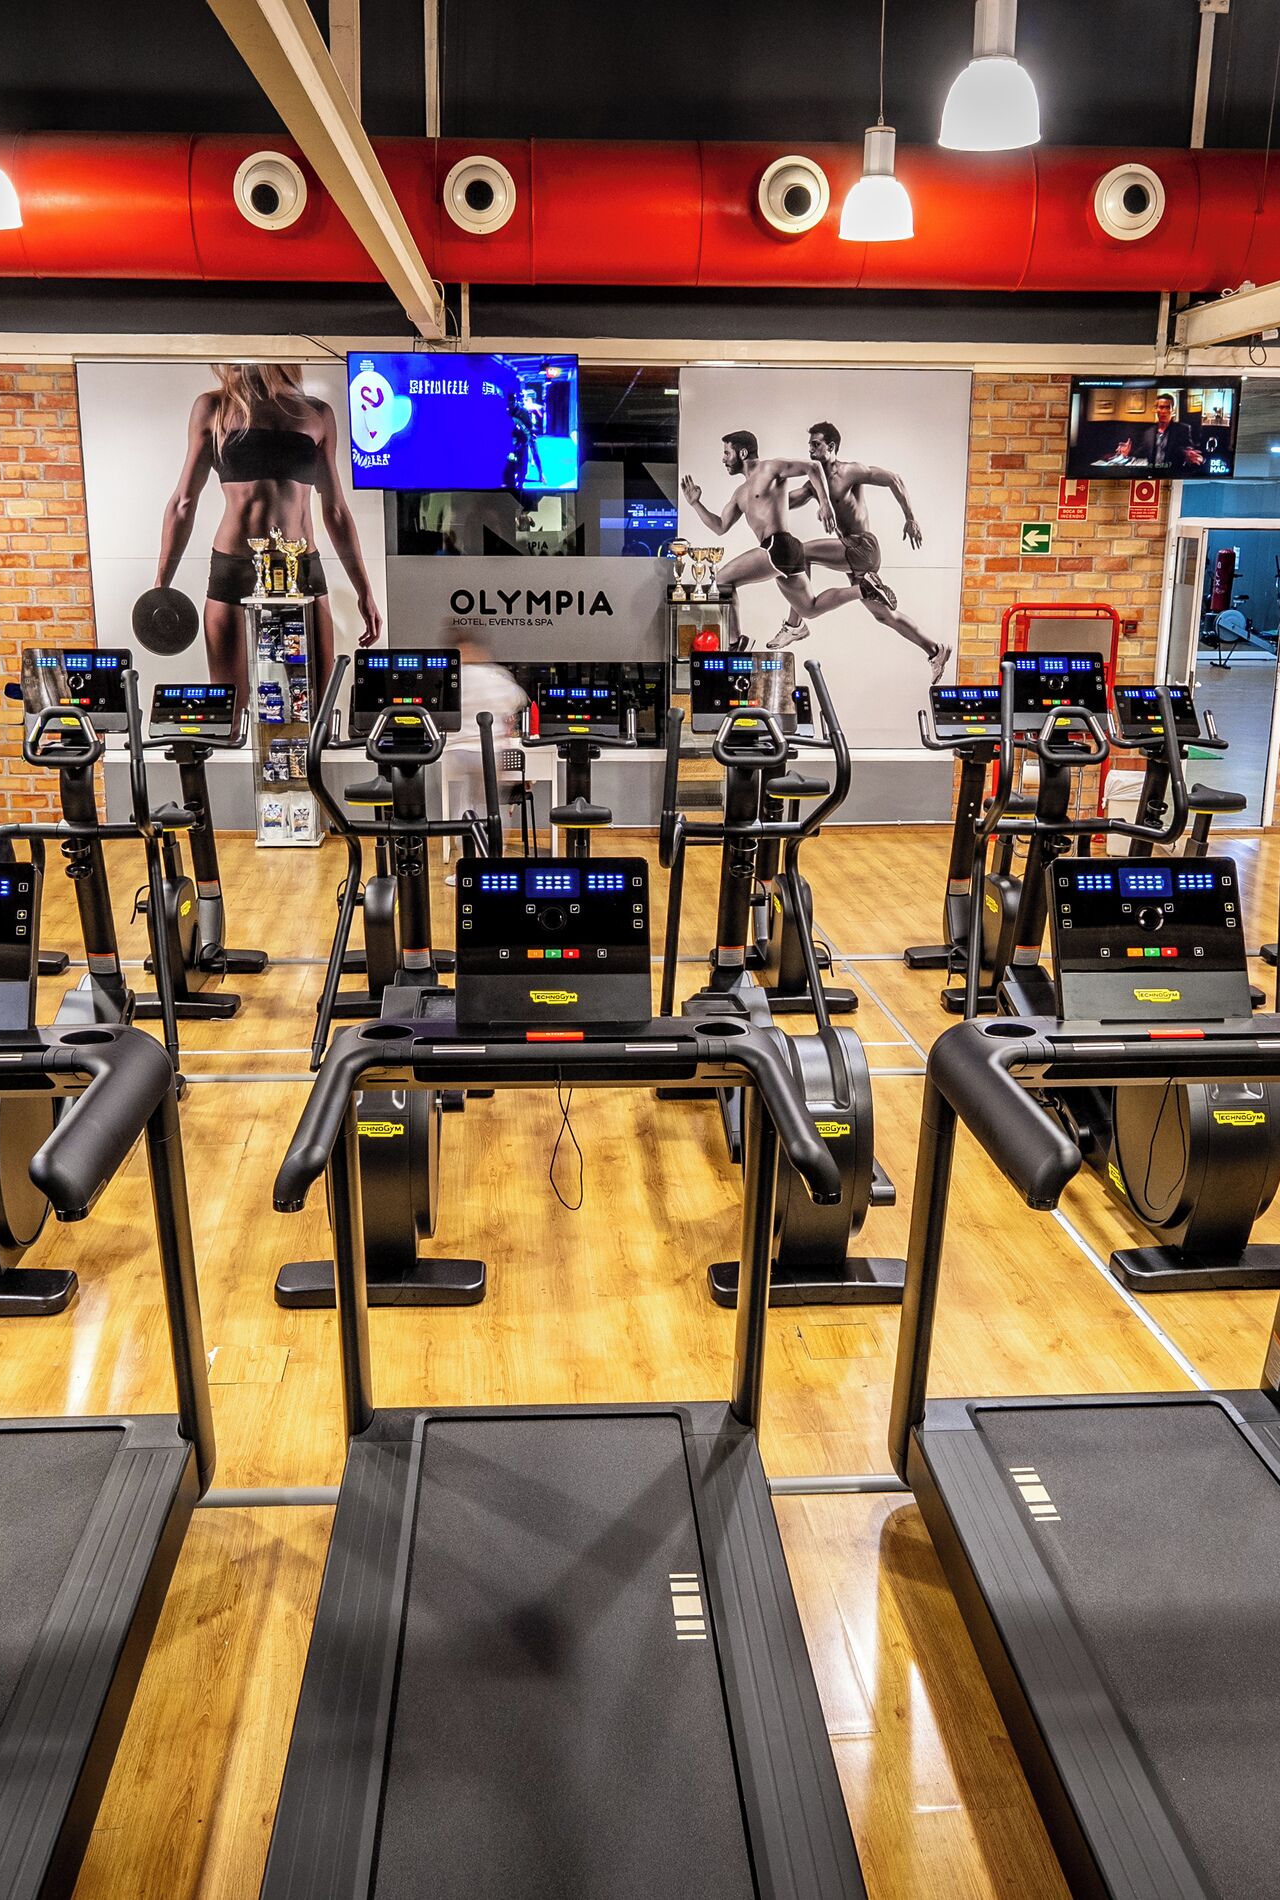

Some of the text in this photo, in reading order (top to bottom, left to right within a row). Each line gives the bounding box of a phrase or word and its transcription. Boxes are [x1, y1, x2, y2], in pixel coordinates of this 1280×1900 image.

[450, 589, 614, 616] OLYMPIA
[452, 618, 554, 627] HOTEL, EVENTS & SPA
[1216, 1113, 1264, 1123] TECHNOGYM
